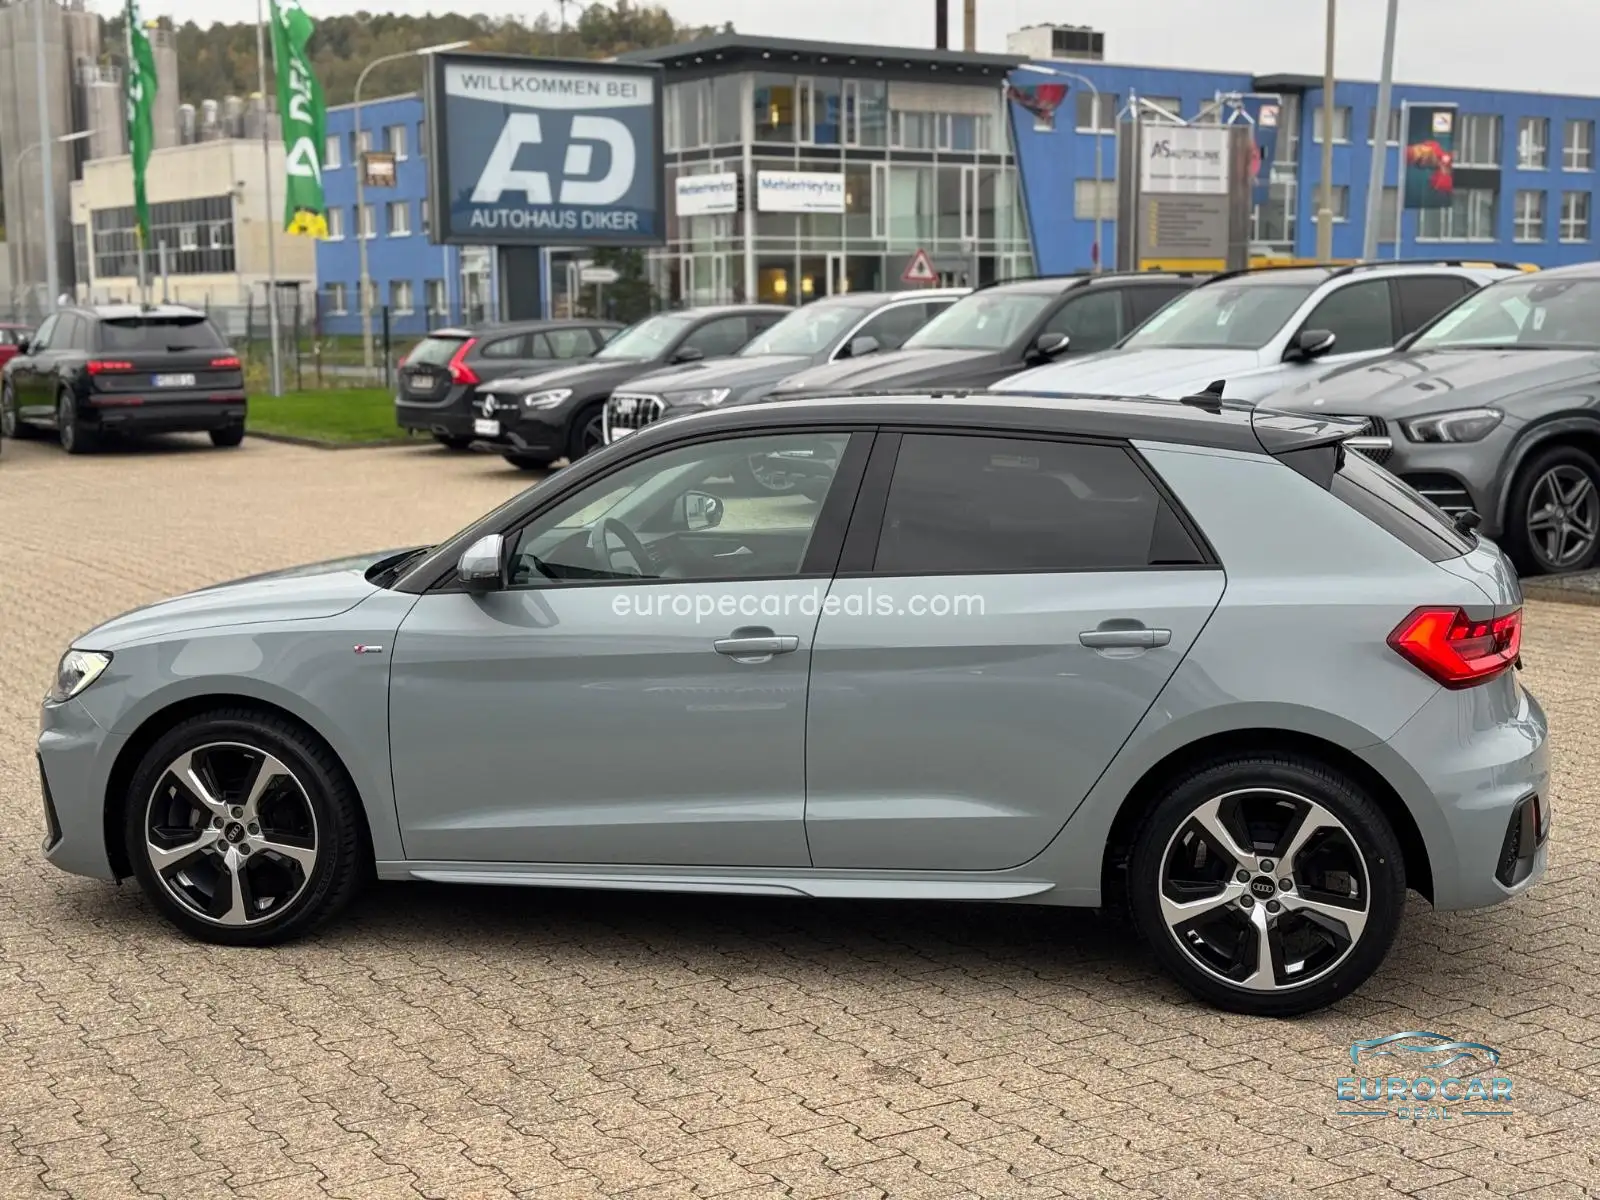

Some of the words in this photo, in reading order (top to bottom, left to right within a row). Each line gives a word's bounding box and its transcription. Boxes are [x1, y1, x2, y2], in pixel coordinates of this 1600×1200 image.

[461, 73, 601, 96] WILLKOMMEN
[606, 82, 638, 98] BEI
[470, 113, 636, 205] AD
[470, 208, 577, 229] AUTOHAUS
[581, 210, 639, 230] DIKER
